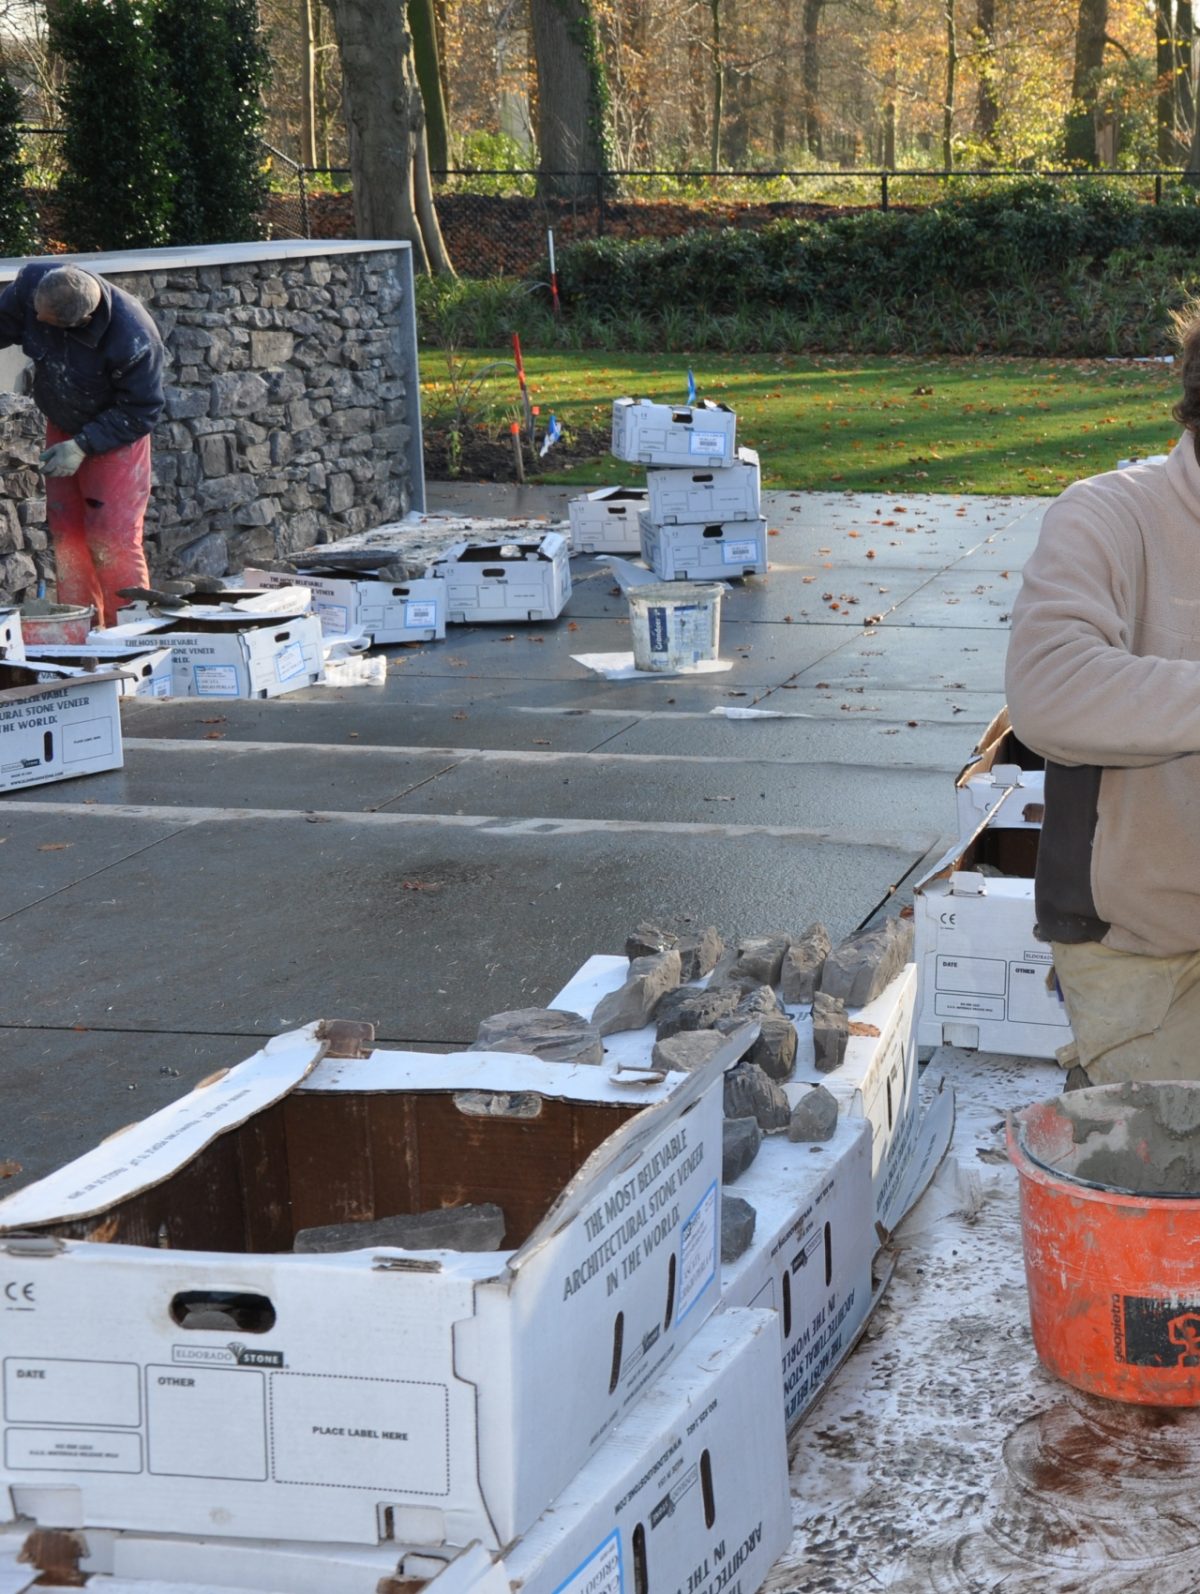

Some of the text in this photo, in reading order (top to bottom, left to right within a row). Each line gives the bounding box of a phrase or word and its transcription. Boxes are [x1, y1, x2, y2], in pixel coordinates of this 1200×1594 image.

[26, 703, 55, 716] STONE
[57, 697, 90, 710] VENEER
[1015, 967, 1035, 975] OTHER
[584, 1128, 688, 1243] THE MOST BELIEVABLE
[563, 1205, 649, 1302] ARCHITECTURAL
[650, 1179, 678, 1220] STONE
[677, 1142, 704, 1187] VENEER
[606, 1267, 620, 1298] IN
[621, 1243, 642, 1281] THE
[808, 1288, 856, 1369] ARCHITECTURAL
[812, 1307, 826, 1335] THE
[1111, 1293, 1124, 1364] geopietra
[16, 1368, 46, 1380] DATE
[175, 1349, 279, 1365] ELDORADO STONE
[782, 1329, 811, 1376] WORL
[157, 1375, 195, 1388] OTHER
[784, 1357, 805, 1401] STON
[312, 1425, 409, 1442] PLACE LABEL HERE
[686, 1539, 726, 1594] IN THE
